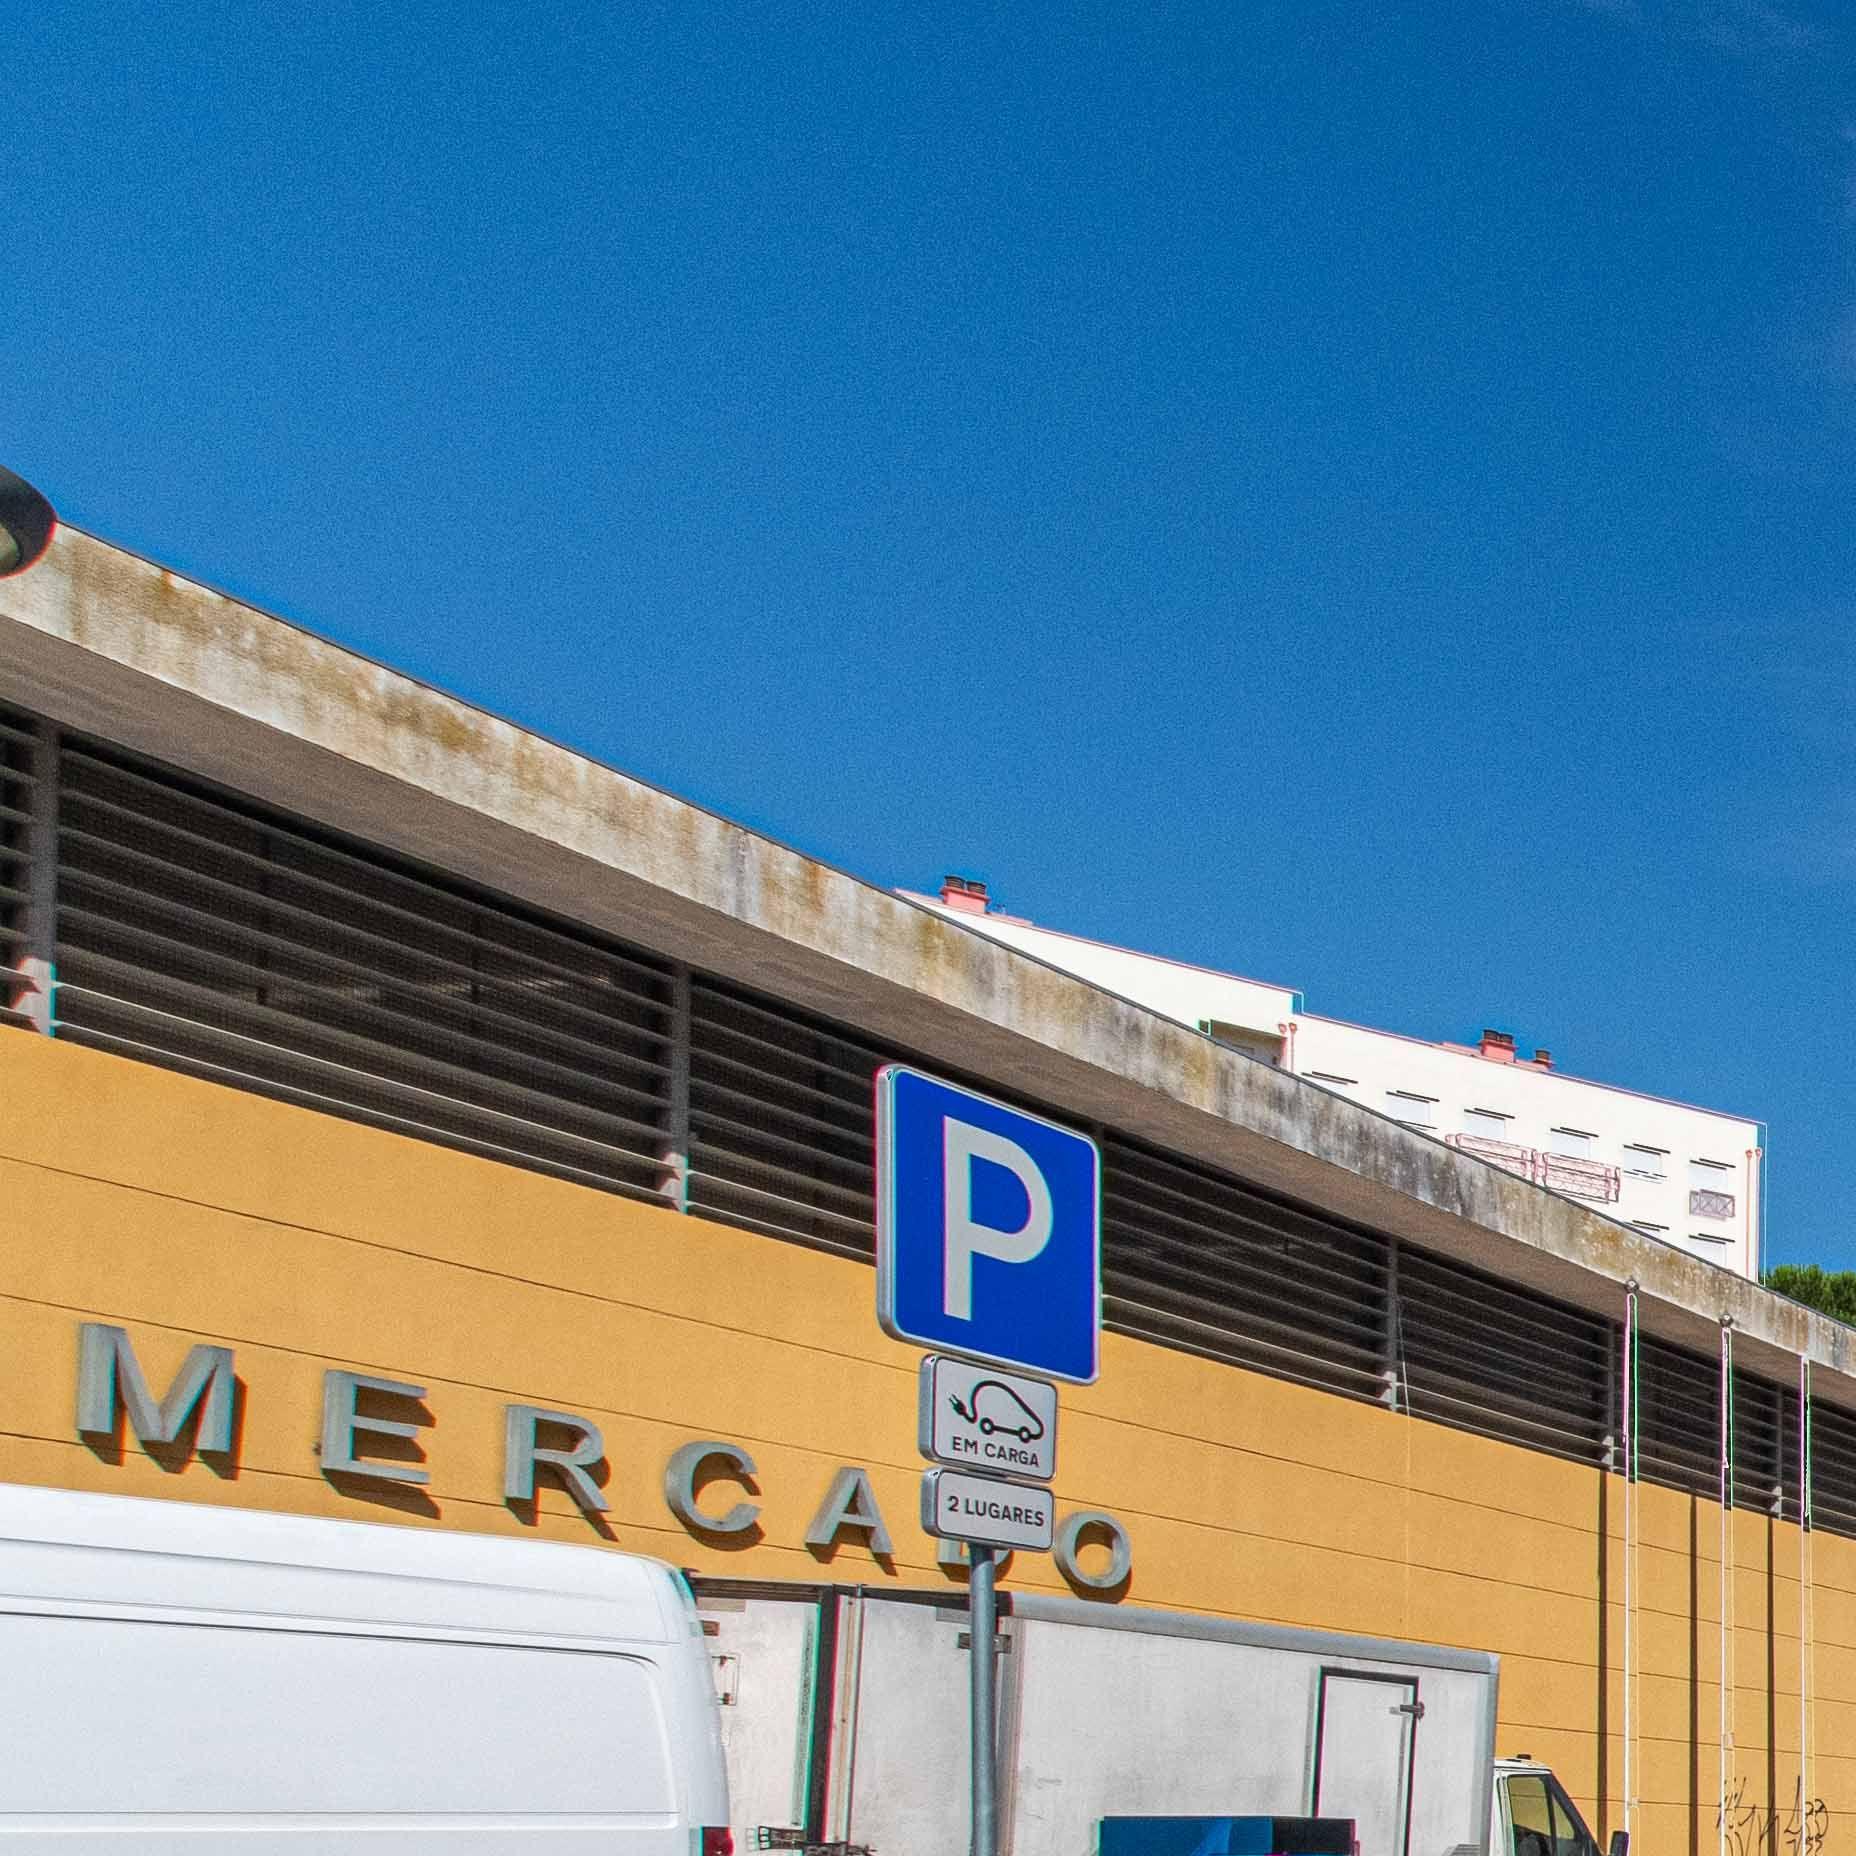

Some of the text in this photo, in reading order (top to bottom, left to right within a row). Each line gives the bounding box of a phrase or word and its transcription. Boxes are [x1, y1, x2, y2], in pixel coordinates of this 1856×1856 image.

[944, 1114, 1054, 1321] P
[77, 1321, 1132, 1592] MERCAO
[948, 1495, 1044, 1527] 2 LUGARES
[952, 1436, 1039, 1467] EM CARGA
